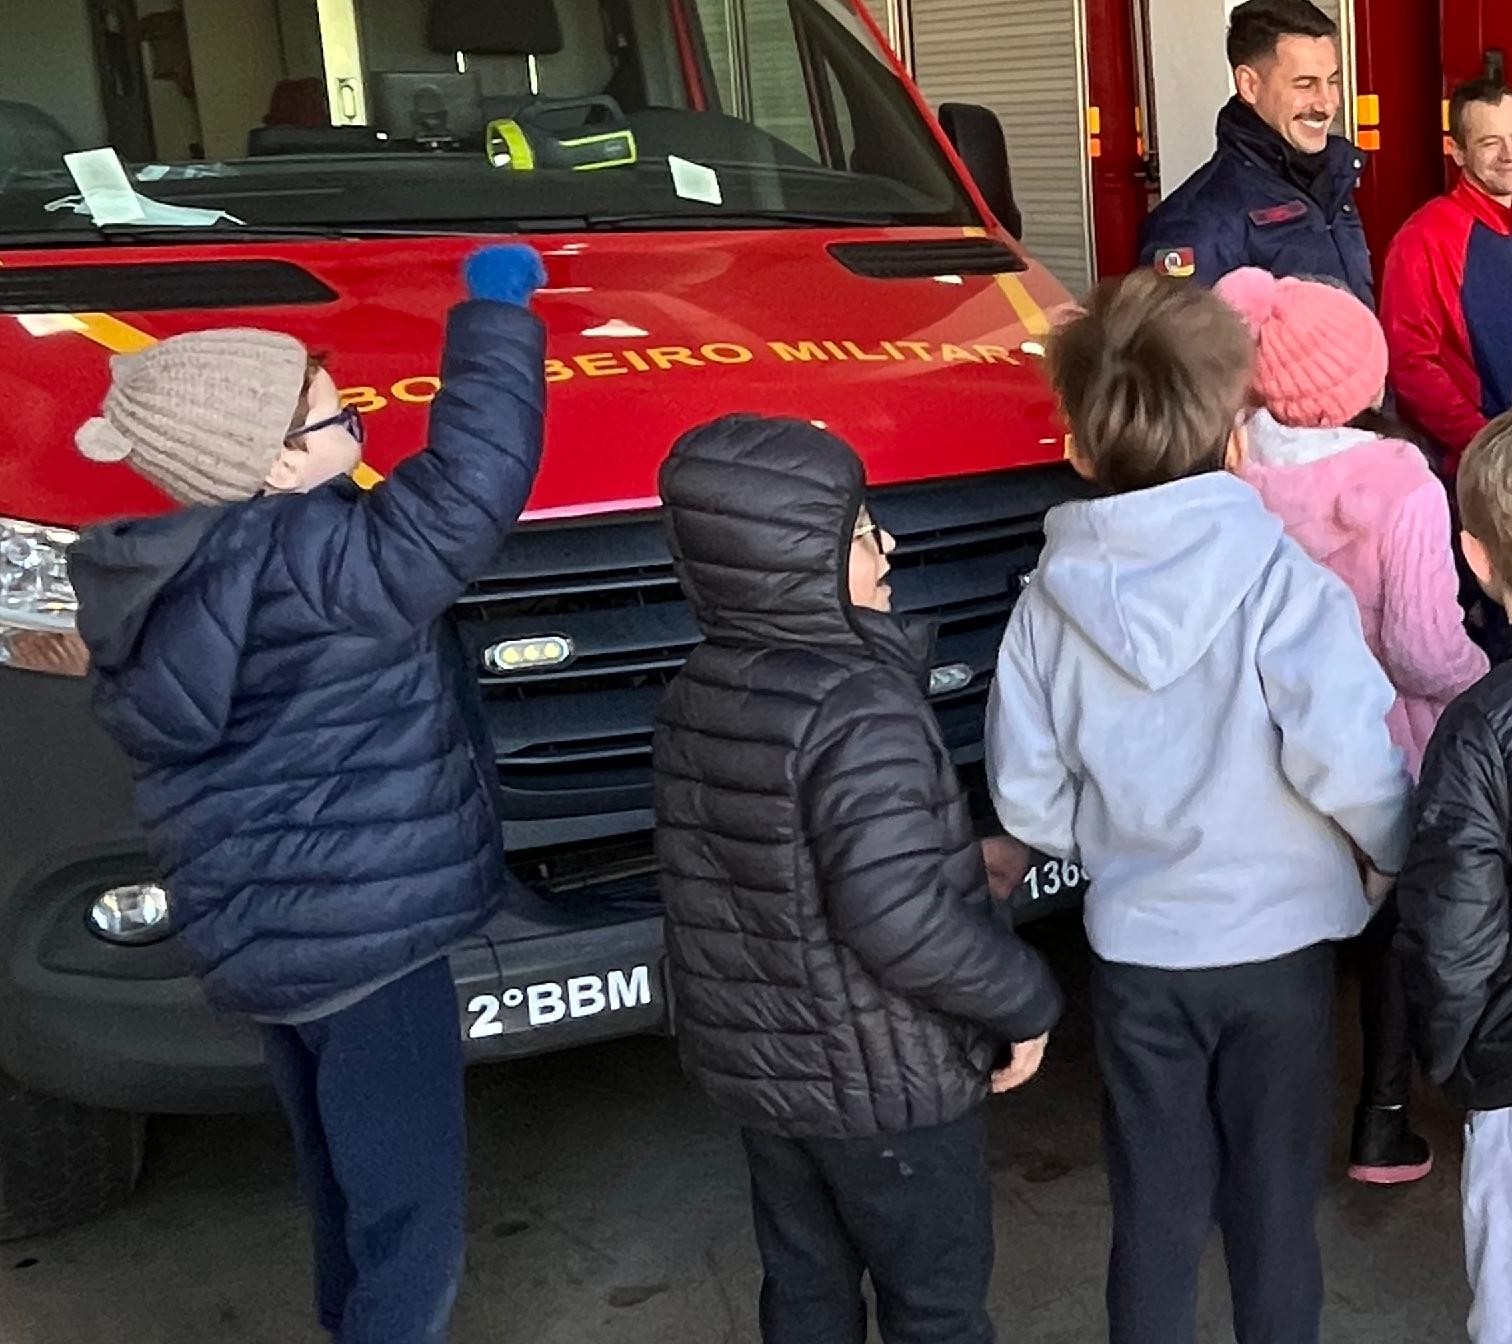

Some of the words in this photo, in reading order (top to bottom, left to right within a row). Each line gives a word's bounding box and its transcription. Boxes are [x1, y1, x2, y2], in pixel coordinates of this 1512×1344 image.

[338, 342, 754, 413] BOBEIRO
[767, 340, 1021, 366] MILITAR
[1023, 860, 1089, 899] 136
[467, 965, 651, 1039] 2°BBM
